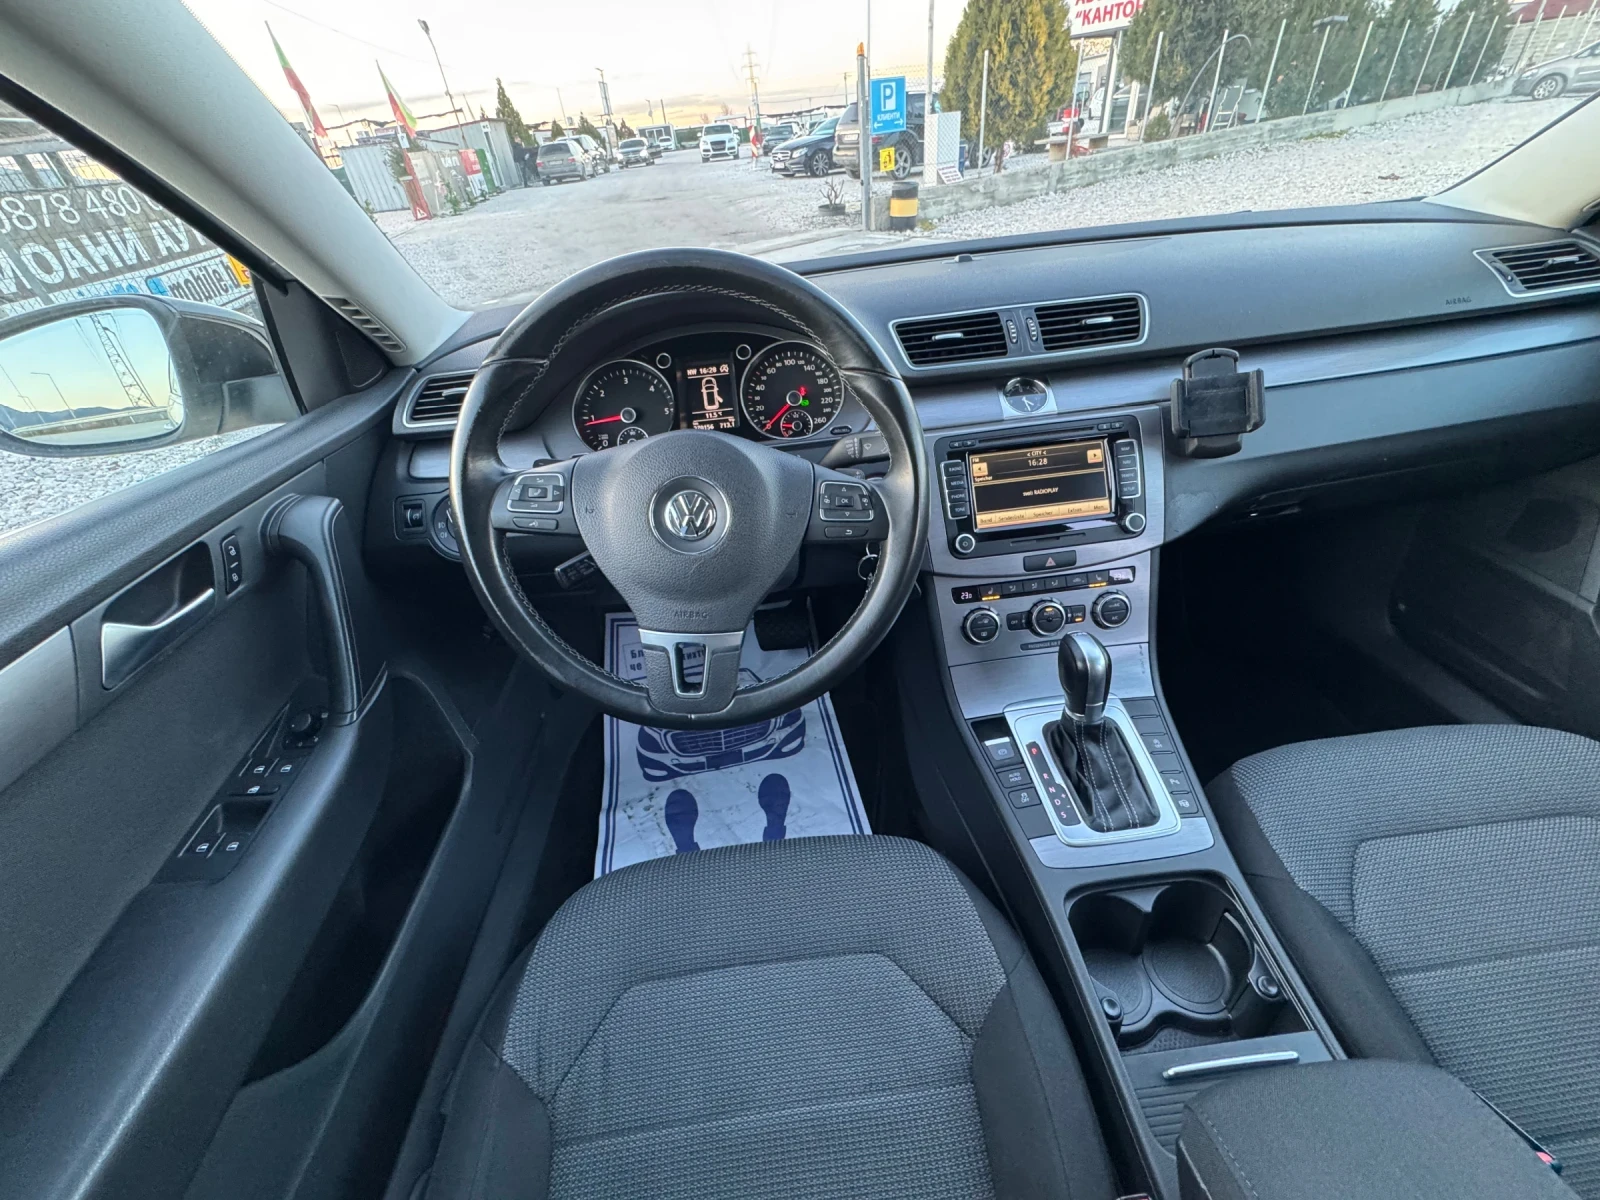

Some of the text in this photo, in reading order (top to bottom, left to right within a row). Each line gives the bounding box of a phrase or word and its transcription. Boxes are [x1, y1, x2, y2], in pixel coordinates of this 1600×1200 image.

[883, 84, 893, 109] P
[877, 112, 900, 121] КЛИЕНТИ
[86, 186, 141, 219] 480
[168, 259, 251, 302] mobile.b
[1446, 296, 1472, 305] AIRBAG
[1028, 458, 1048, 466] 16:28
[674, 611, 709, 619] AIRBAG
